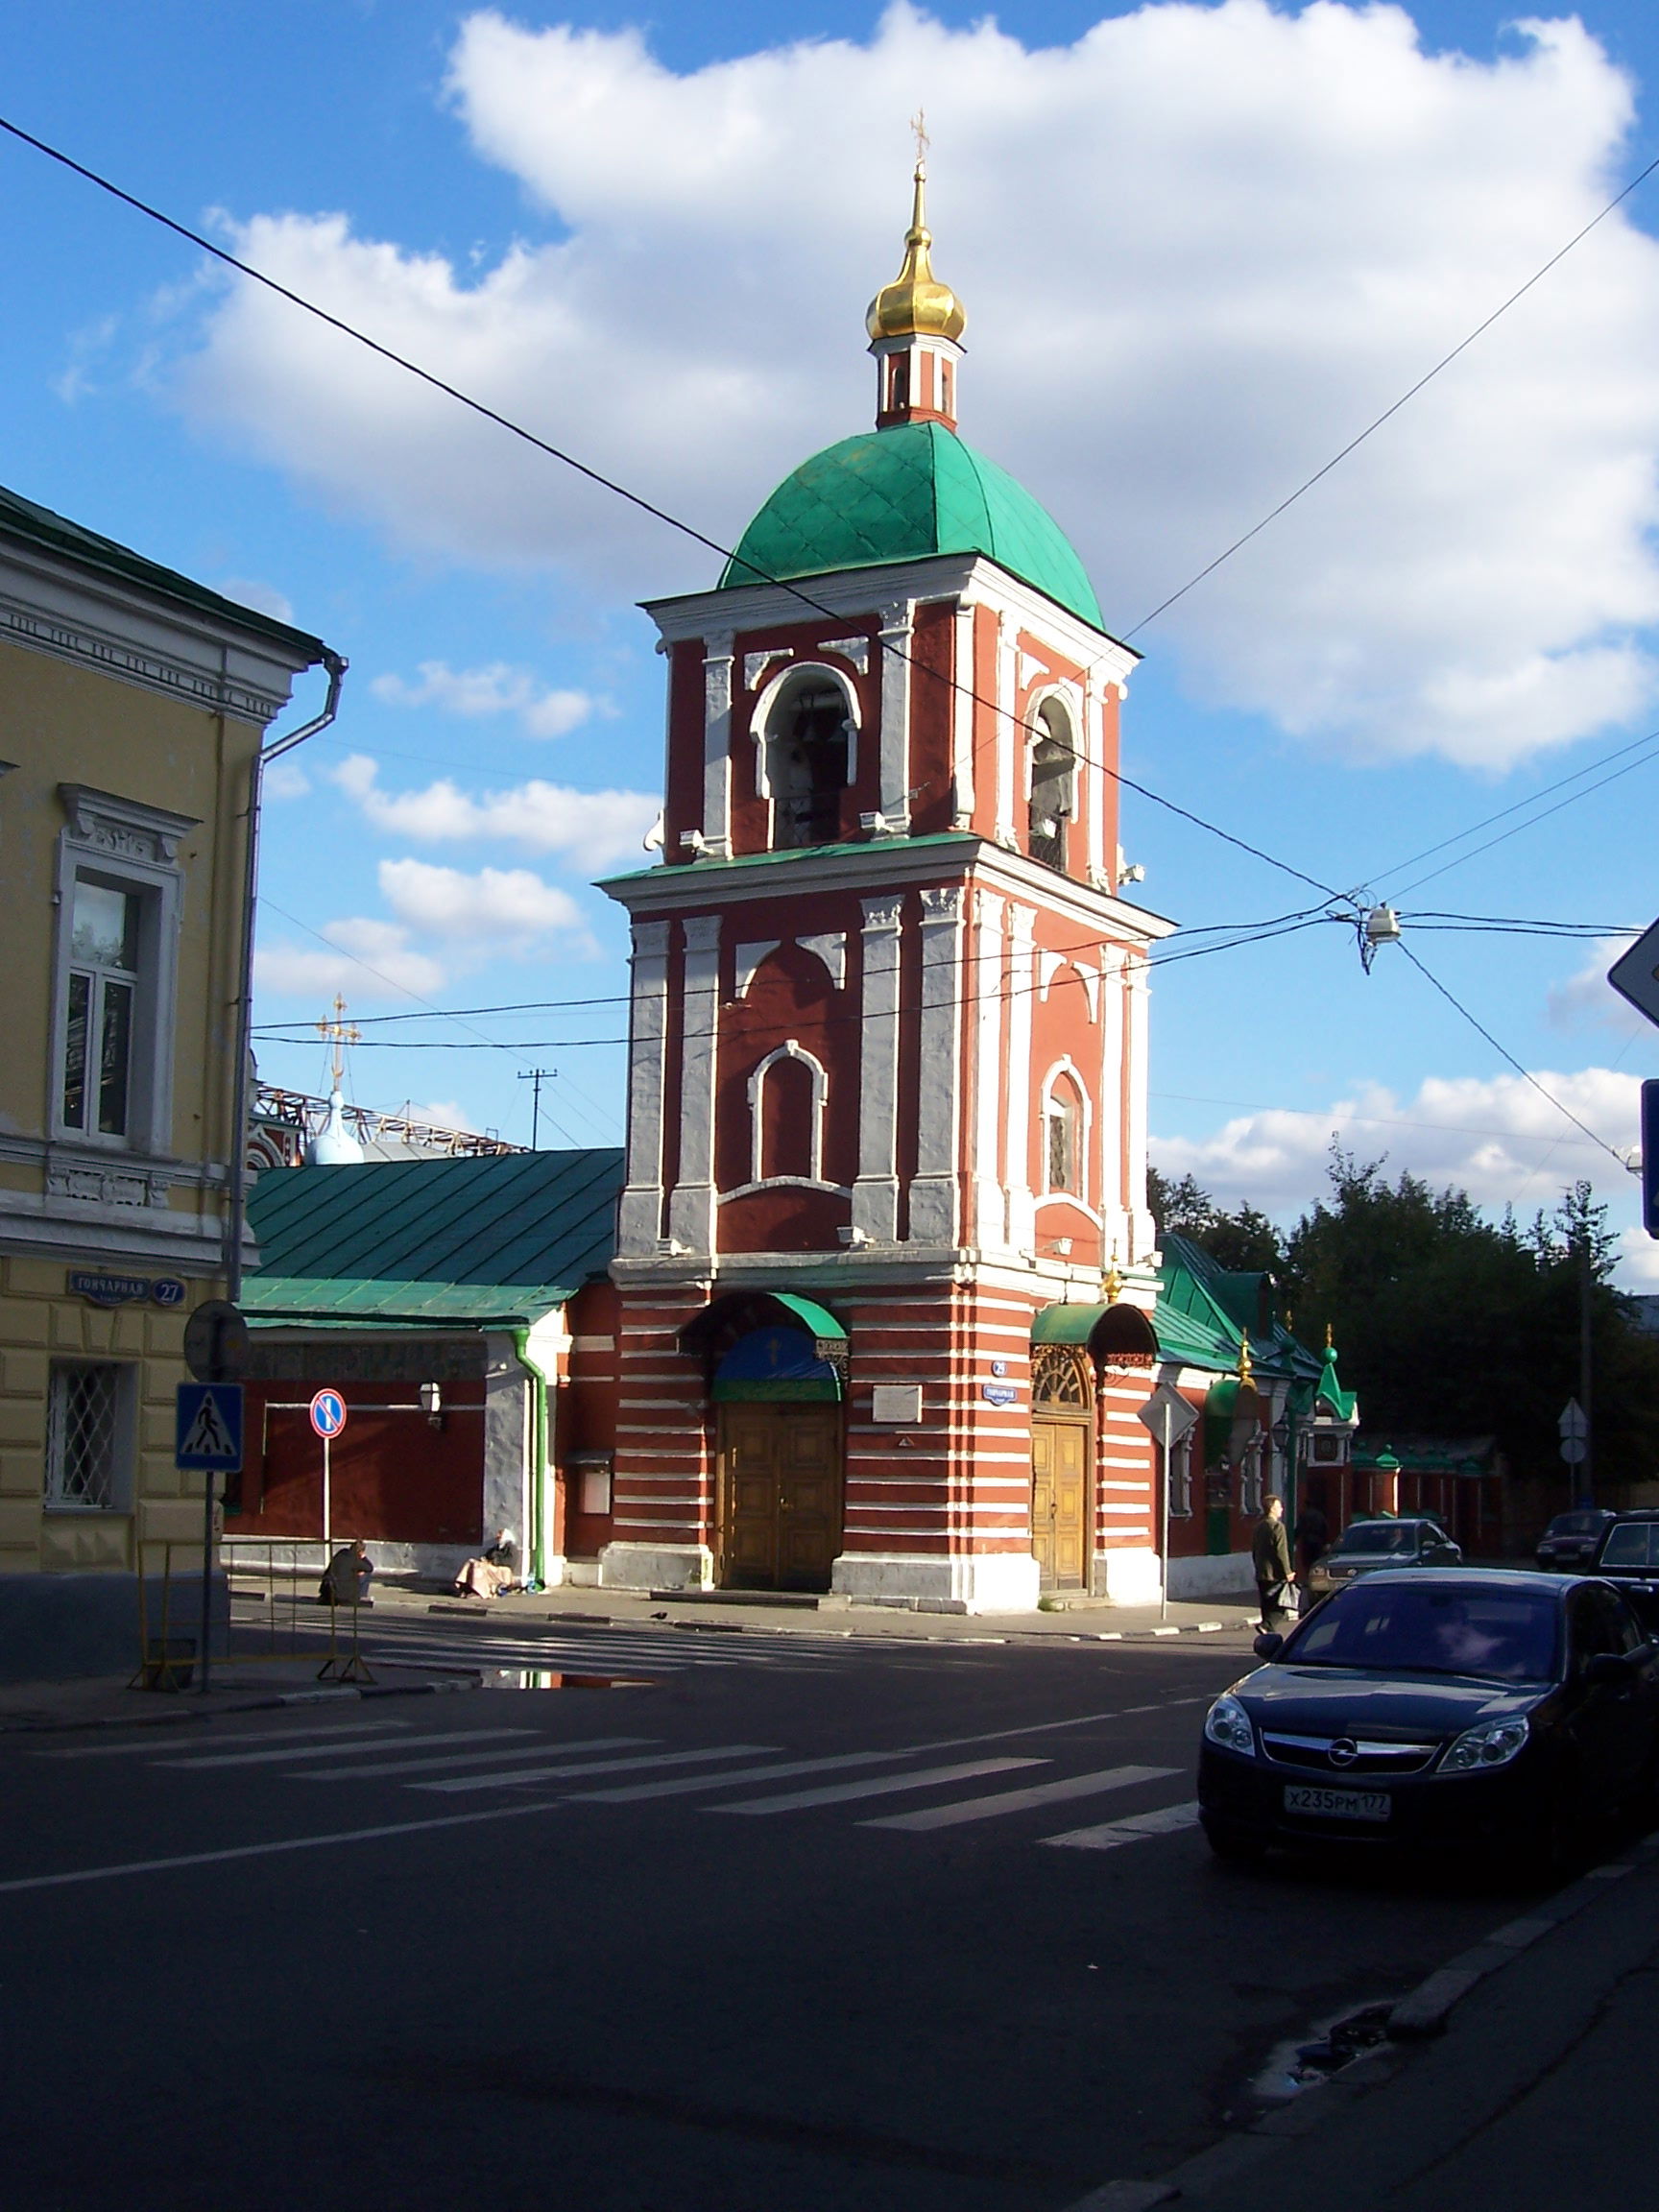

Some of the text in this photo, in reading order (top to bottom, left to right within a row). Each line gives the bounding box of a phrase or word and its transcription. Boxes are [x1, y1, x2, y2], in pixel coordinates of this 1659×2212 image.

[78, 1277, 144, 1295] ГОНЧАРНАЯ
[160, 1283, 179, 1302] 27
[1360, 1794, 1387, 1809] 177
